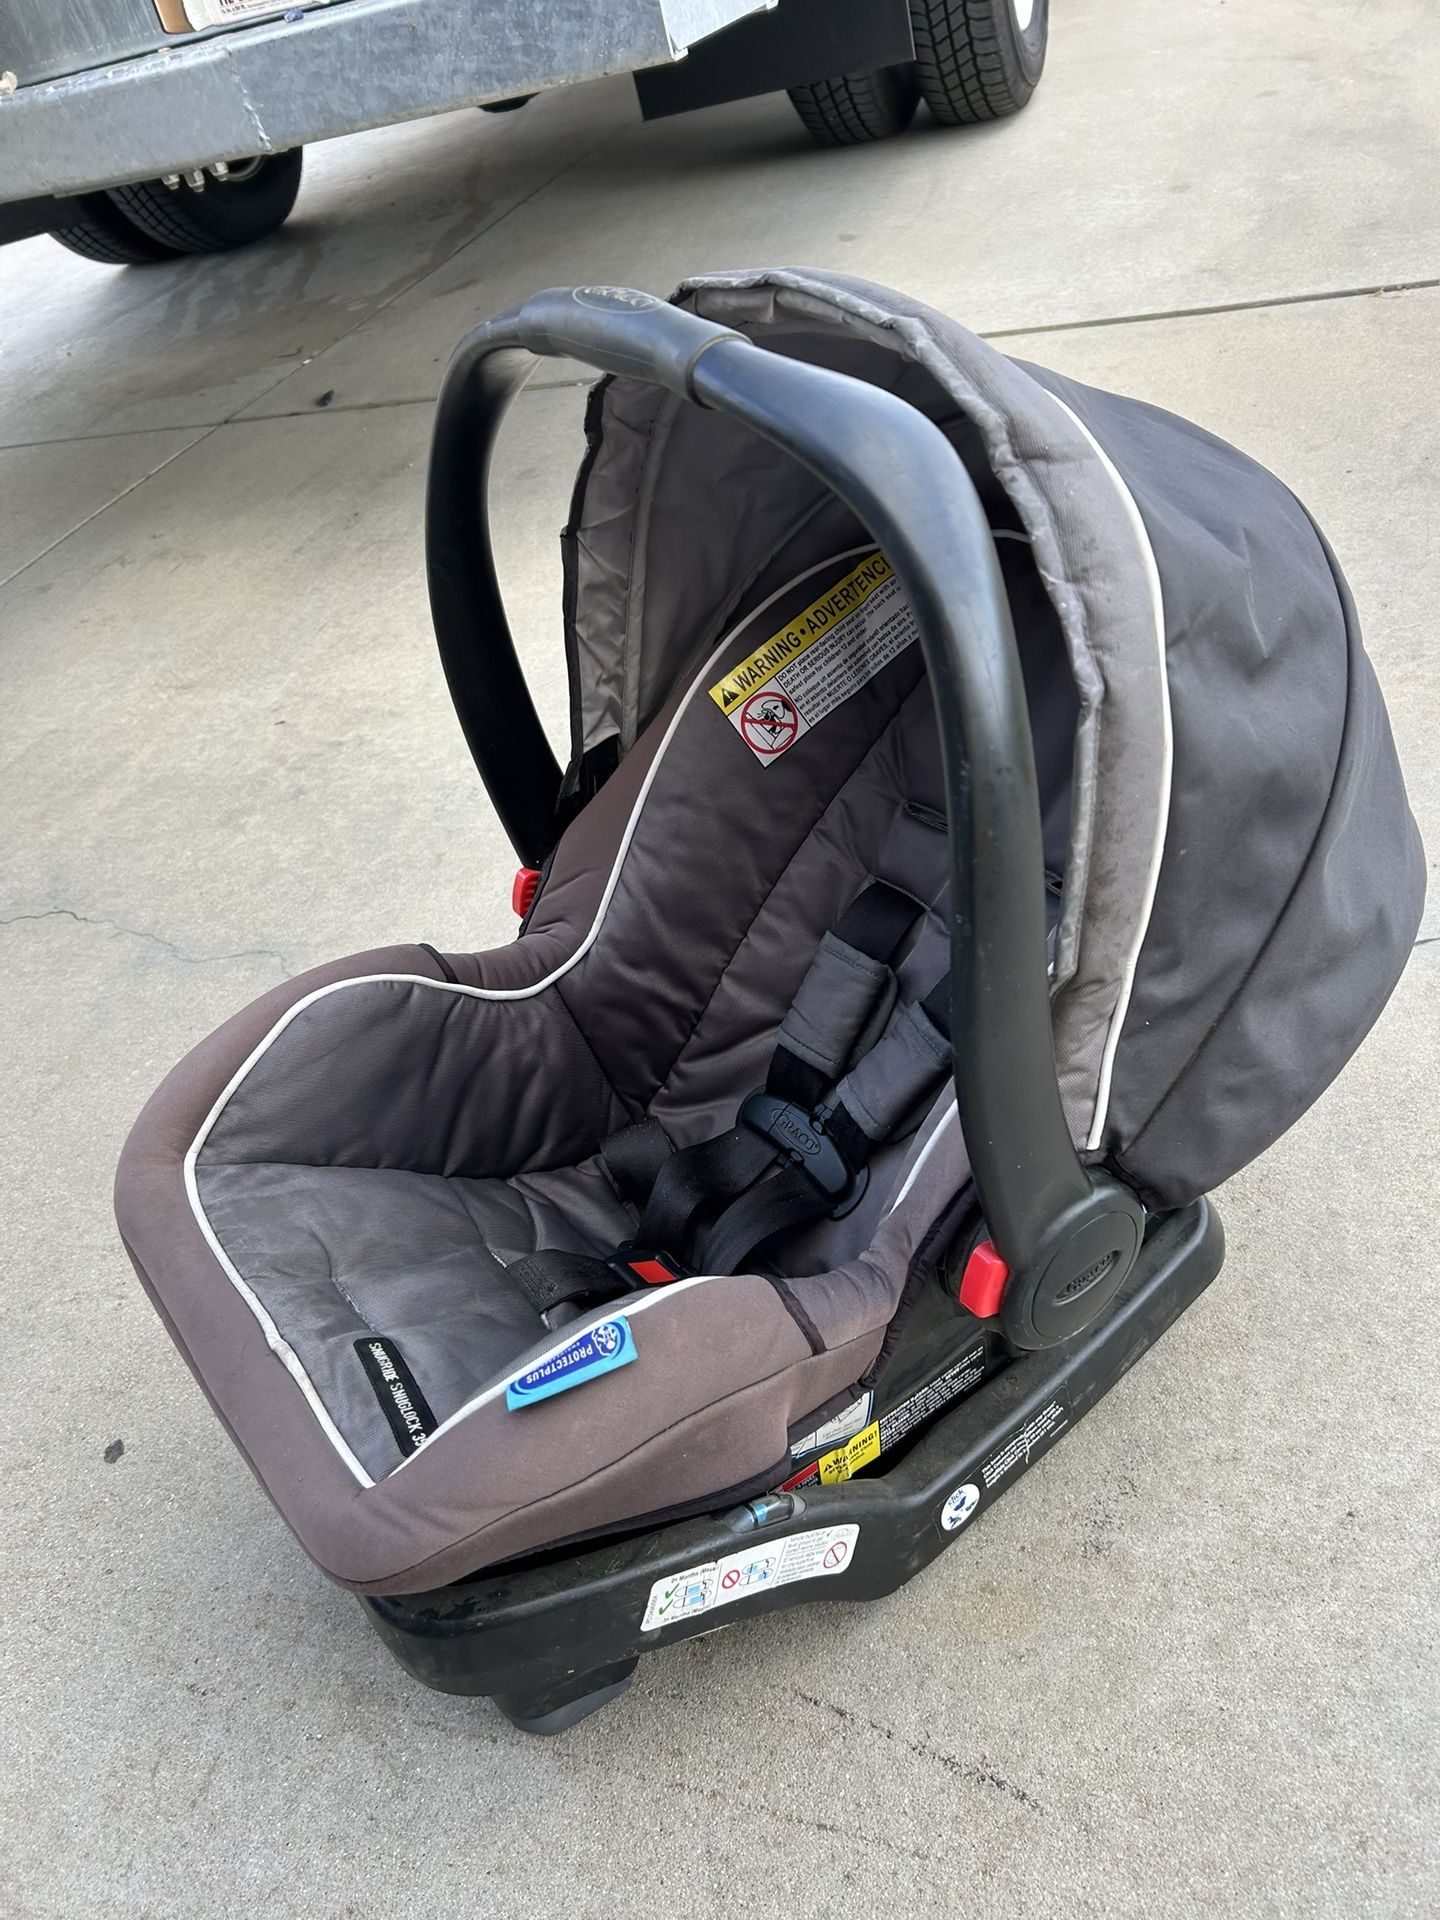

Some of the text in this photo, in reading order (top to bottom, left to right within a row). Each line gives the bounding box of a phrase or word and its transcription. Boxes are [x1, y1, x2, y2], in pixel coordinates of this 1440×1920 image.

[733, 557, 890, 691] WARNING ADVERTENCI
[778, 672, 787, 681] DO
[786, 663, 797, 674] NOT
[797, 654, 811, 667] place
[783, 672, 801, 688] DEATH
[799, 665, 809, 674] OR
[807, 648, 830, 667] SERIOUS
[829, 634, 846, 650] INJURY
[789, 680, 804, 695] safest
[803, 671, 816, 684] place
[823, 649, 842, 666] children
[847, 636, 856, 646] and
[827, 679, 847, 697] MUERTE
[778, 1113, 815, 1150] GRACO
[369, 1342, 398, 1383] SNUGRIDE
[390, 1383, 422, 1432] SNUGLOCK
